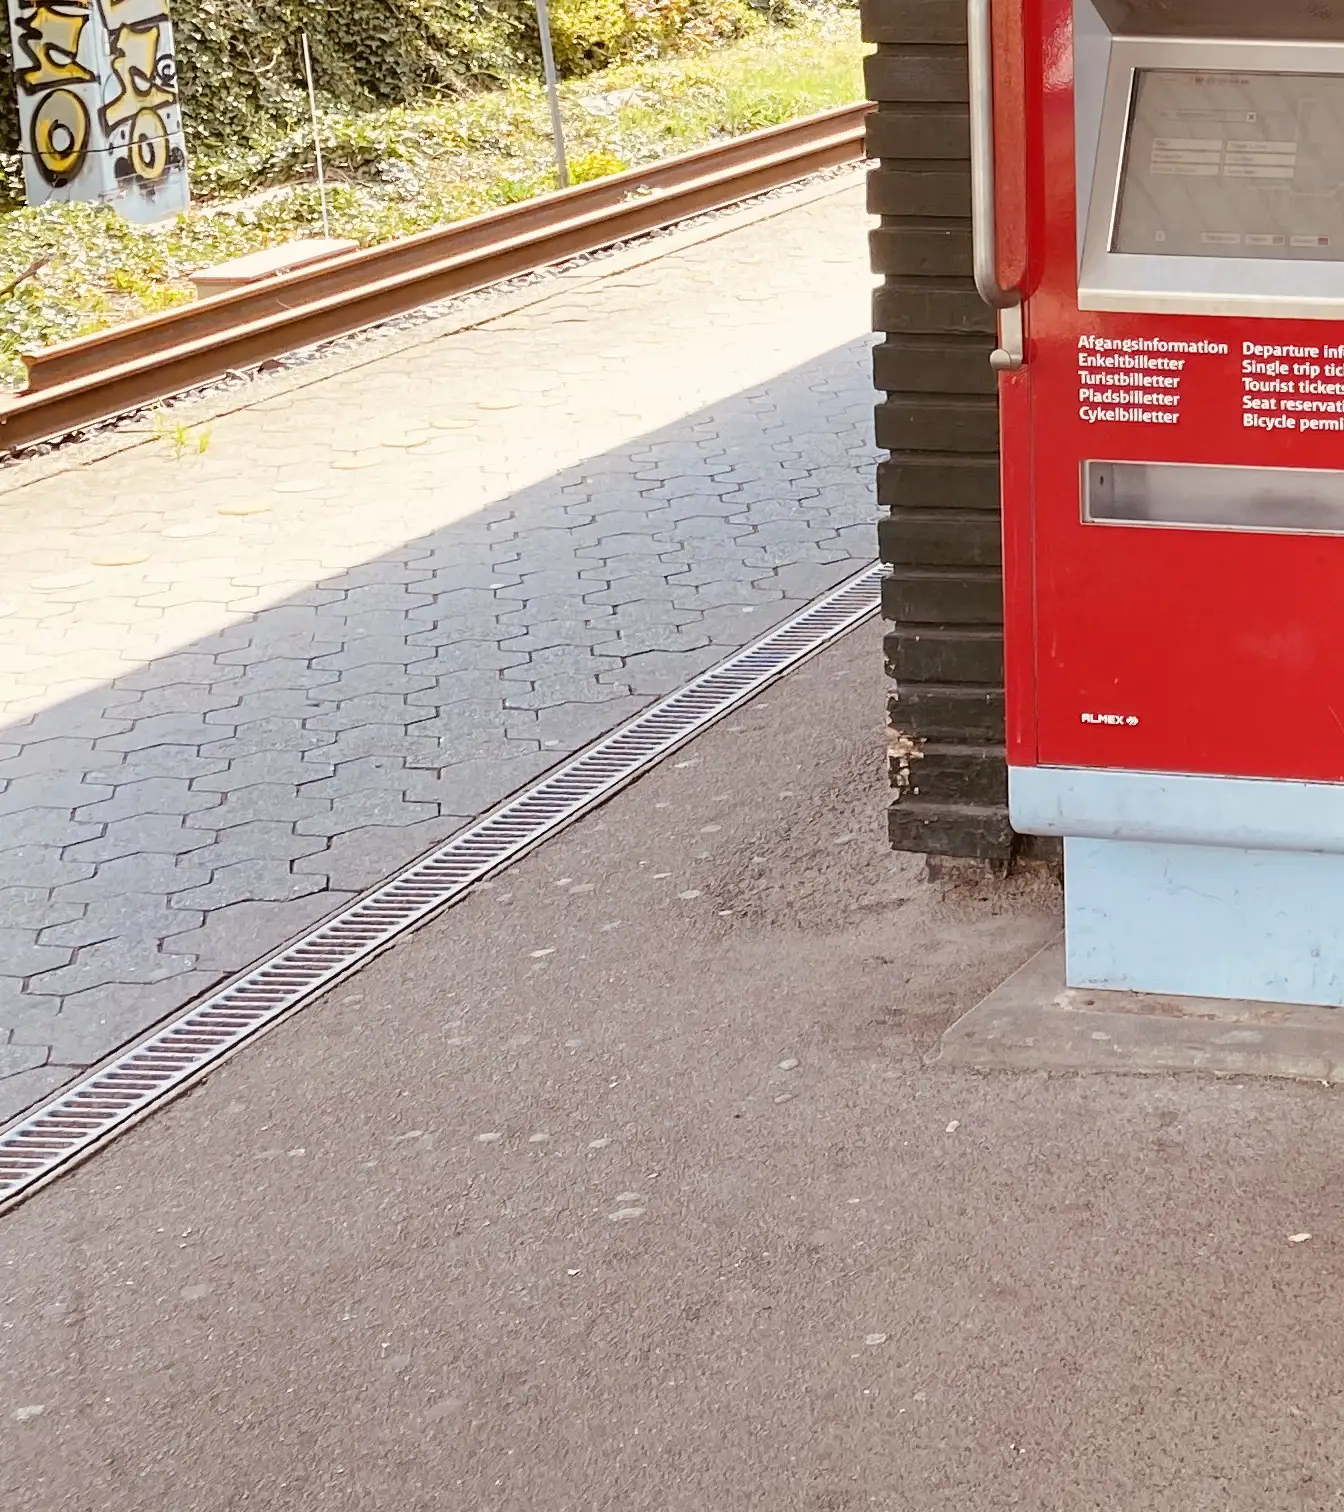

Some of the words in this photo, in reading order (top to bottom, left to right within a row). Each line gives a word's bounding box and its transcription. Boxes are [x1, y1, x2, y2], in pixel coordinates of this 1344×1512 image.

[1078, 334, 1229, 355] Afgangsinformation
[1242, 341, 1319, 358] Departure
[1078, 352, 1185, 371] Enkeltbilletter
[1242, 359, 1289, 376] Single
[1293, 362, 1321, 379] trip
[1078, 370, 1180, 388] Turistbilletter
[1242, 377, 1295, 393] Tourist
[1079, 388, 1180, 406] Pladsbilletter
[1242, 396, 1277, 412] Seat
[1079, 406, 1179, 424] Cykelbilletter
[1243, 414, 1296, 431] Bicycle
[1081, 713, 1124, 725] ALMEX
